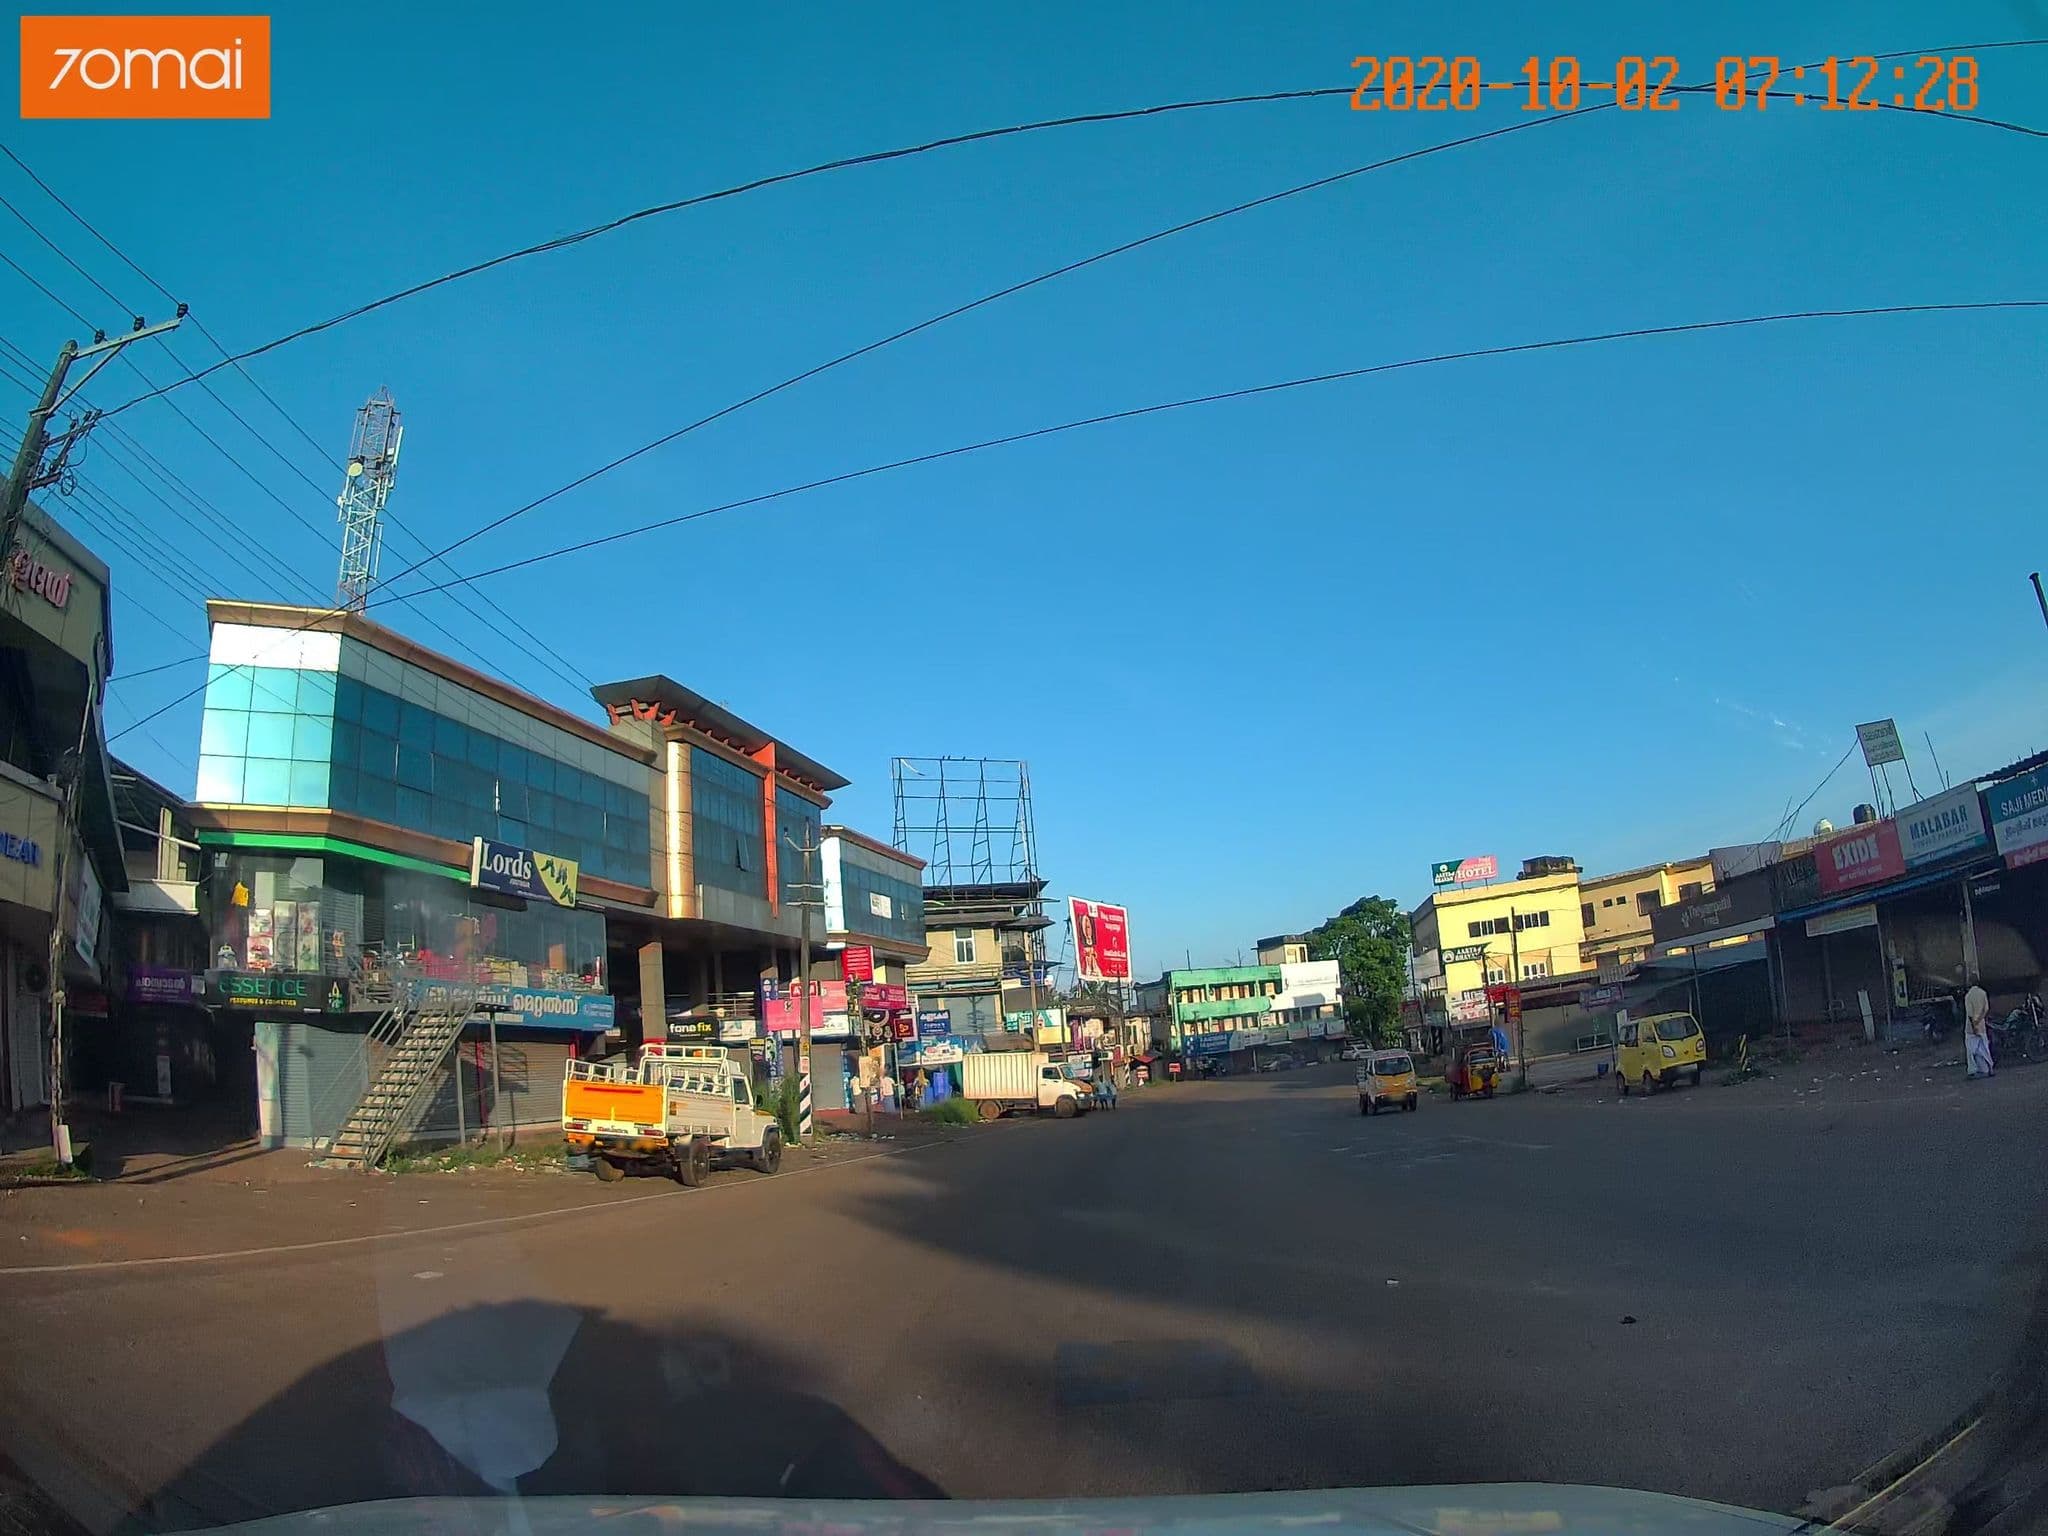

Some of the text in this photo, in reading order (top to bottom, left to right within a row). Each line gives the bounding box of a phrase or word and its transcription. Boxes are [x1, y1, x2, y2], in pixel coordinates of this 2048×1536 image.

[1909, 804, 1968, 840] MALABAR
[2001, 796, 2024, 816] SAJI
[481, 842, 532, 880] Lords
[1832, 834, 1879, 870] EXIDE
[1457, 866, 1495, 879] HOTEL
